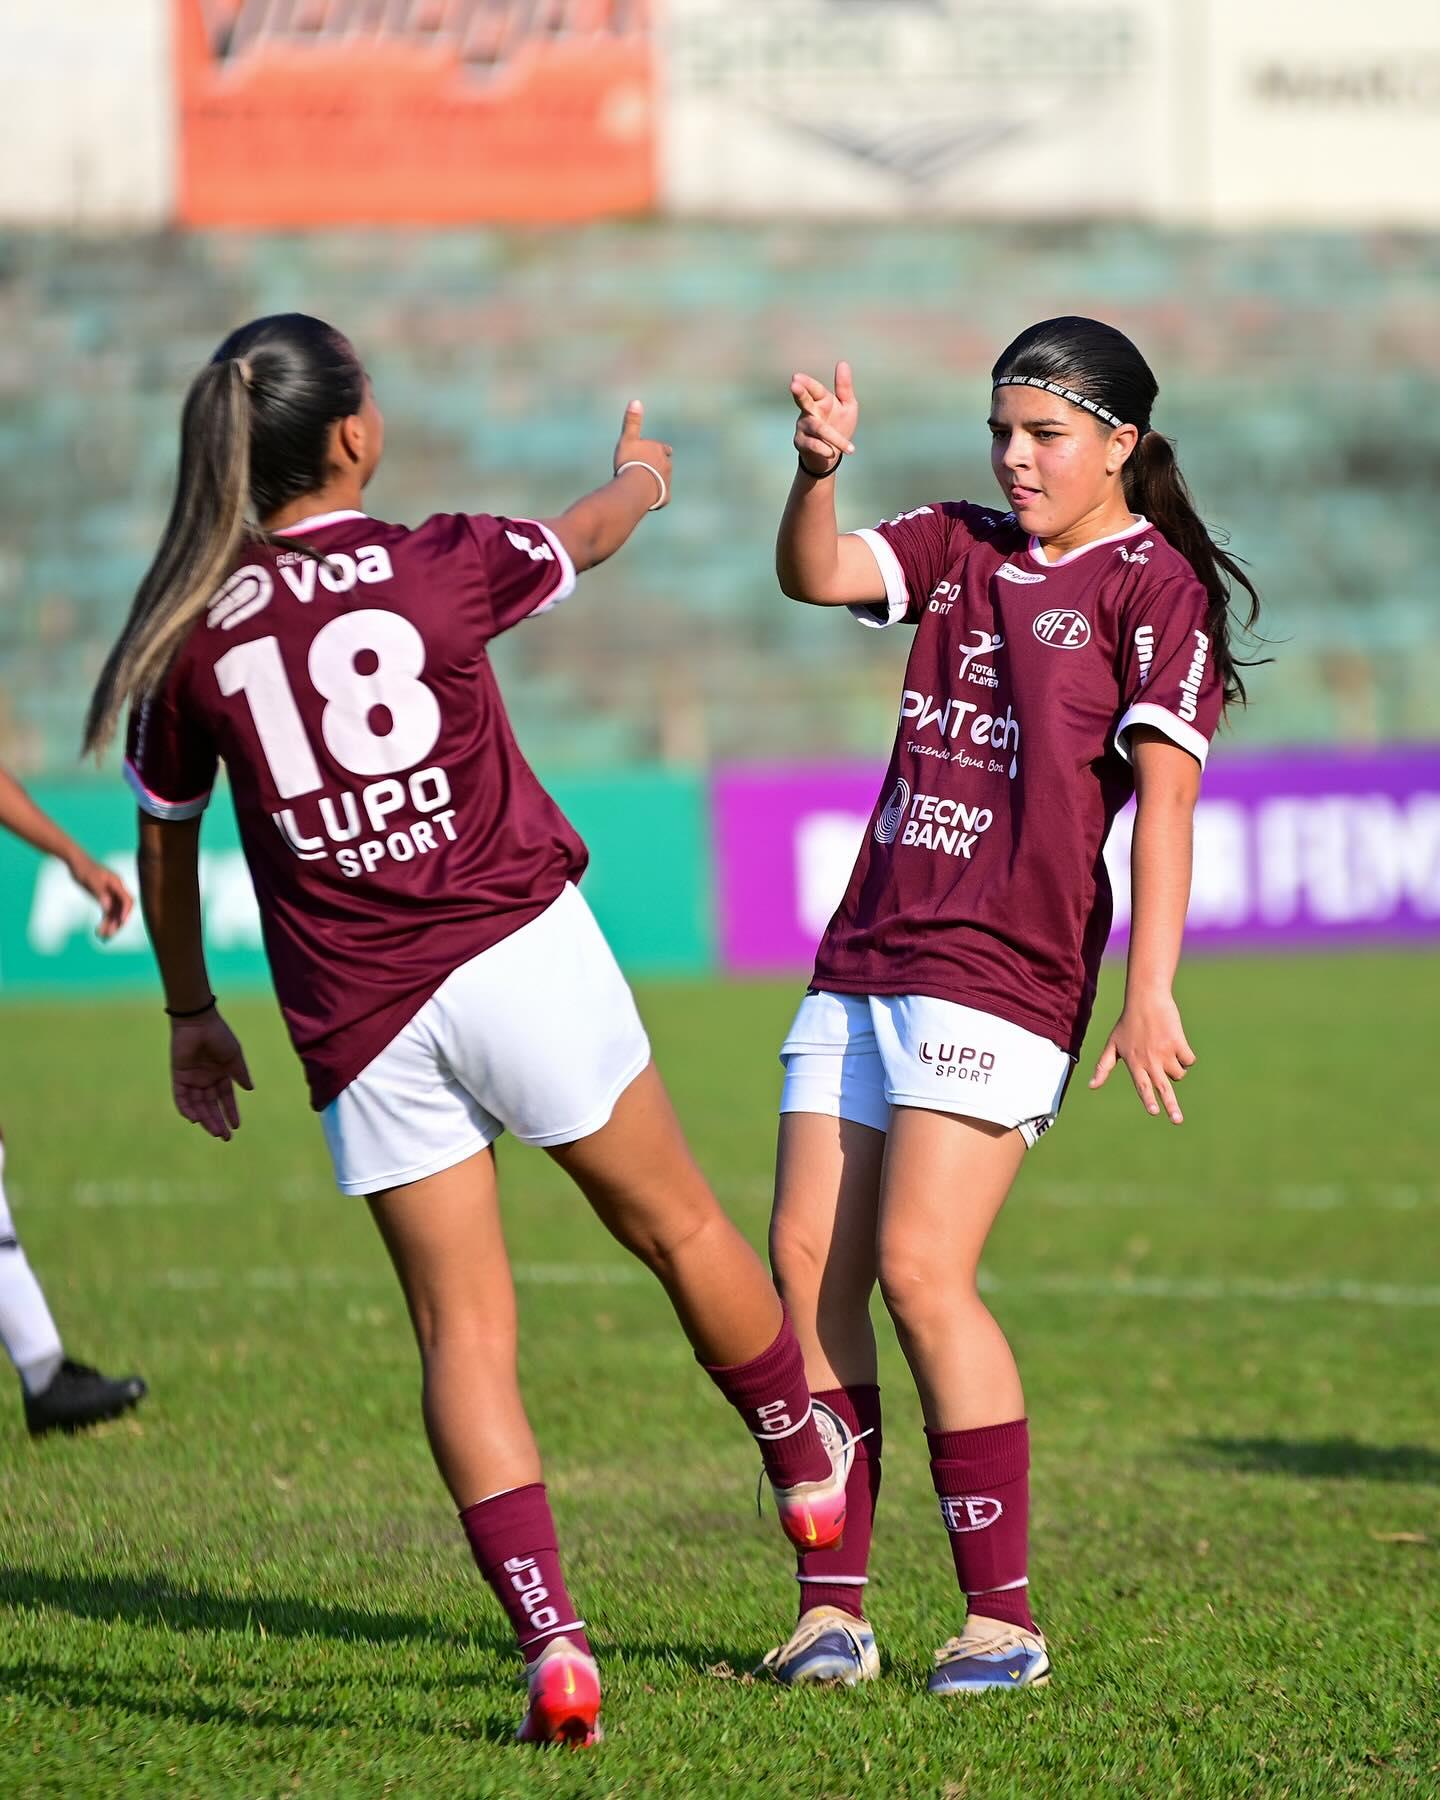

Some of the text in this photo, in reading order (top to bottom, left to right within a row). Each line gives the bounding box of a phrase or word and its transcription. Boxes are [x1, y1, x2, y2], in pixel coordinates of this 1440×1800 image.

[1027, 377, 1048, 388] NIKE
[1045, 382, 1066, 396] NIKE
[1063, 390, 1084, 403] NIKE
[1081, 399, 1099, 412] NIKE
[1096, 407, 1113, 420] NIKE
[278, 545, 394, 603] voa
[1036, 612, 1086, 645] AFE
[968, 673, 999, 689] PLAYER
[971, 663, 997, 677] TOTAL
[213, 609, 440, 799] 18
[900, 690, 1019, 752] PWTech
[907, 741, 1005, 773] Trazendo Água Boa
[272, 766, 451, 861] LUPO
[910, 794, 993, 833] TECNO
[335, 809, 457, 878] SPORT
[901, 820, 979, 859] BANK
[919, 1042, 995, 1071] LUPO
[935, 1064, 992, 1085] SPORT
[503, 1556, 561, 1630] LUPO
